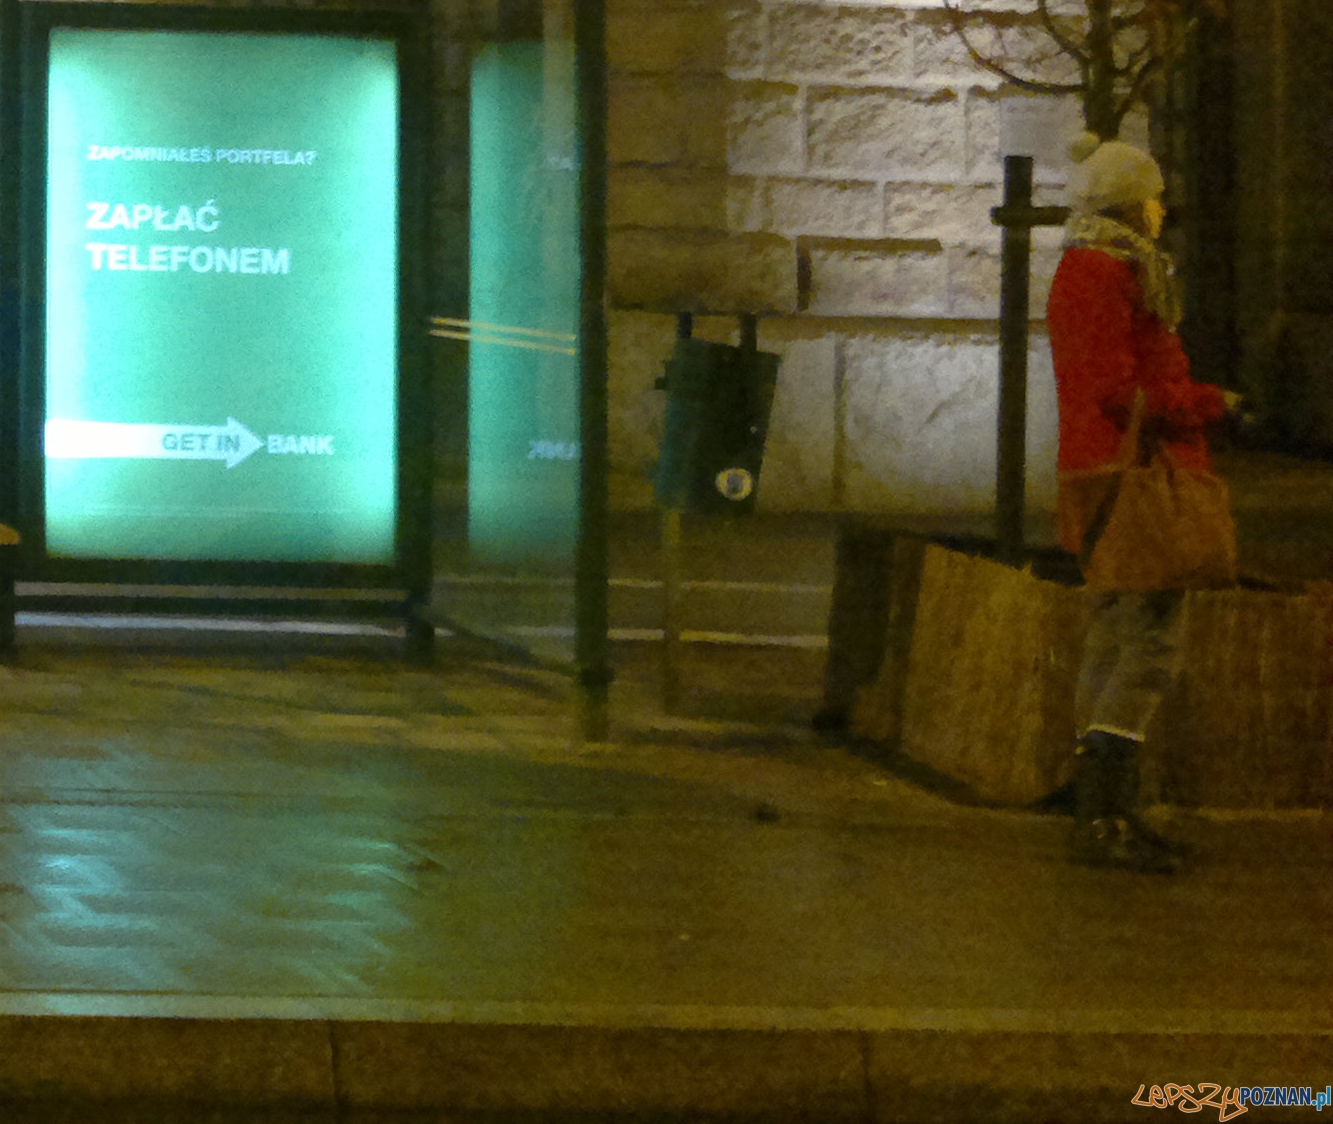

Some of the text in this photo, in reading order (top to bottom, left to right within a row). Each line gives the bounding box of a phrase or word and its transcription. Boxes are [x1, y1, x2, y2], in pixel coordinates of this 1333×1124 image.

[86, 144, 317, 165] ZAPOMNIAŁEŚ PORTFELA?
[86, 198, 221, 232] ZAPŁAĆ
[85, 242, 292, 275] TELEFONEM
[162, 433, 335, 456] GET IN BANK
